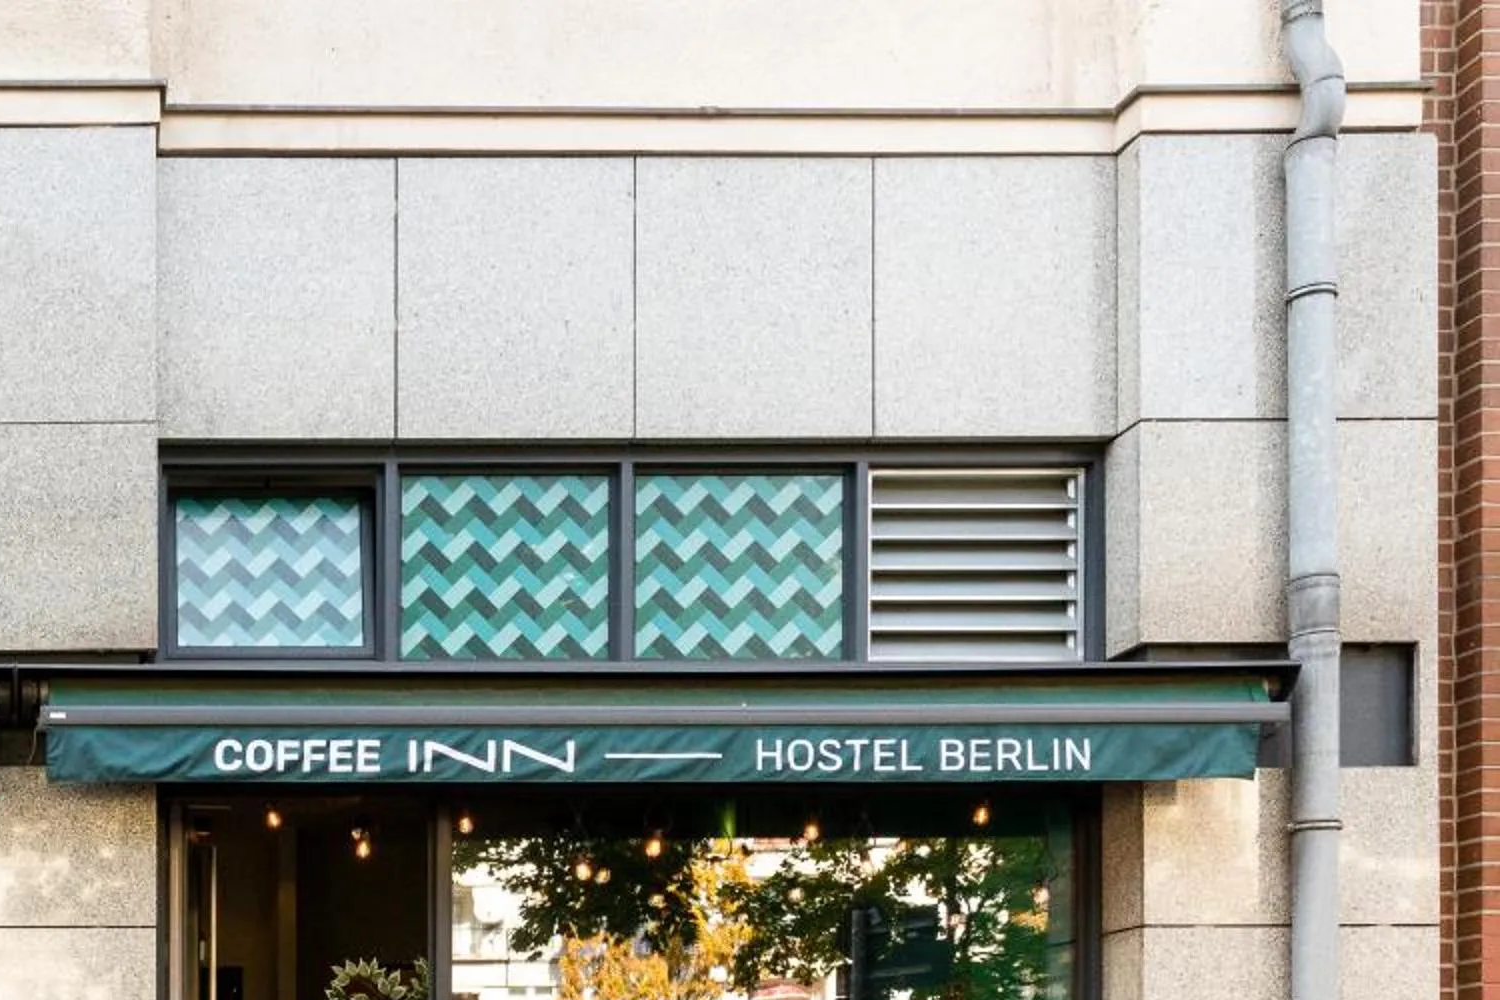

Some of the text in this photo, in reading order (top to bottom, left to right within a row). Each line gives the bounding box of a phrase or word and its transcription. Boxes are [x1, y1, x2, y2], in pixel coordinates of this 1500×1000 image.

[213, 738, 1092, 773] COFFEE INN HOSTEL BERLIN
